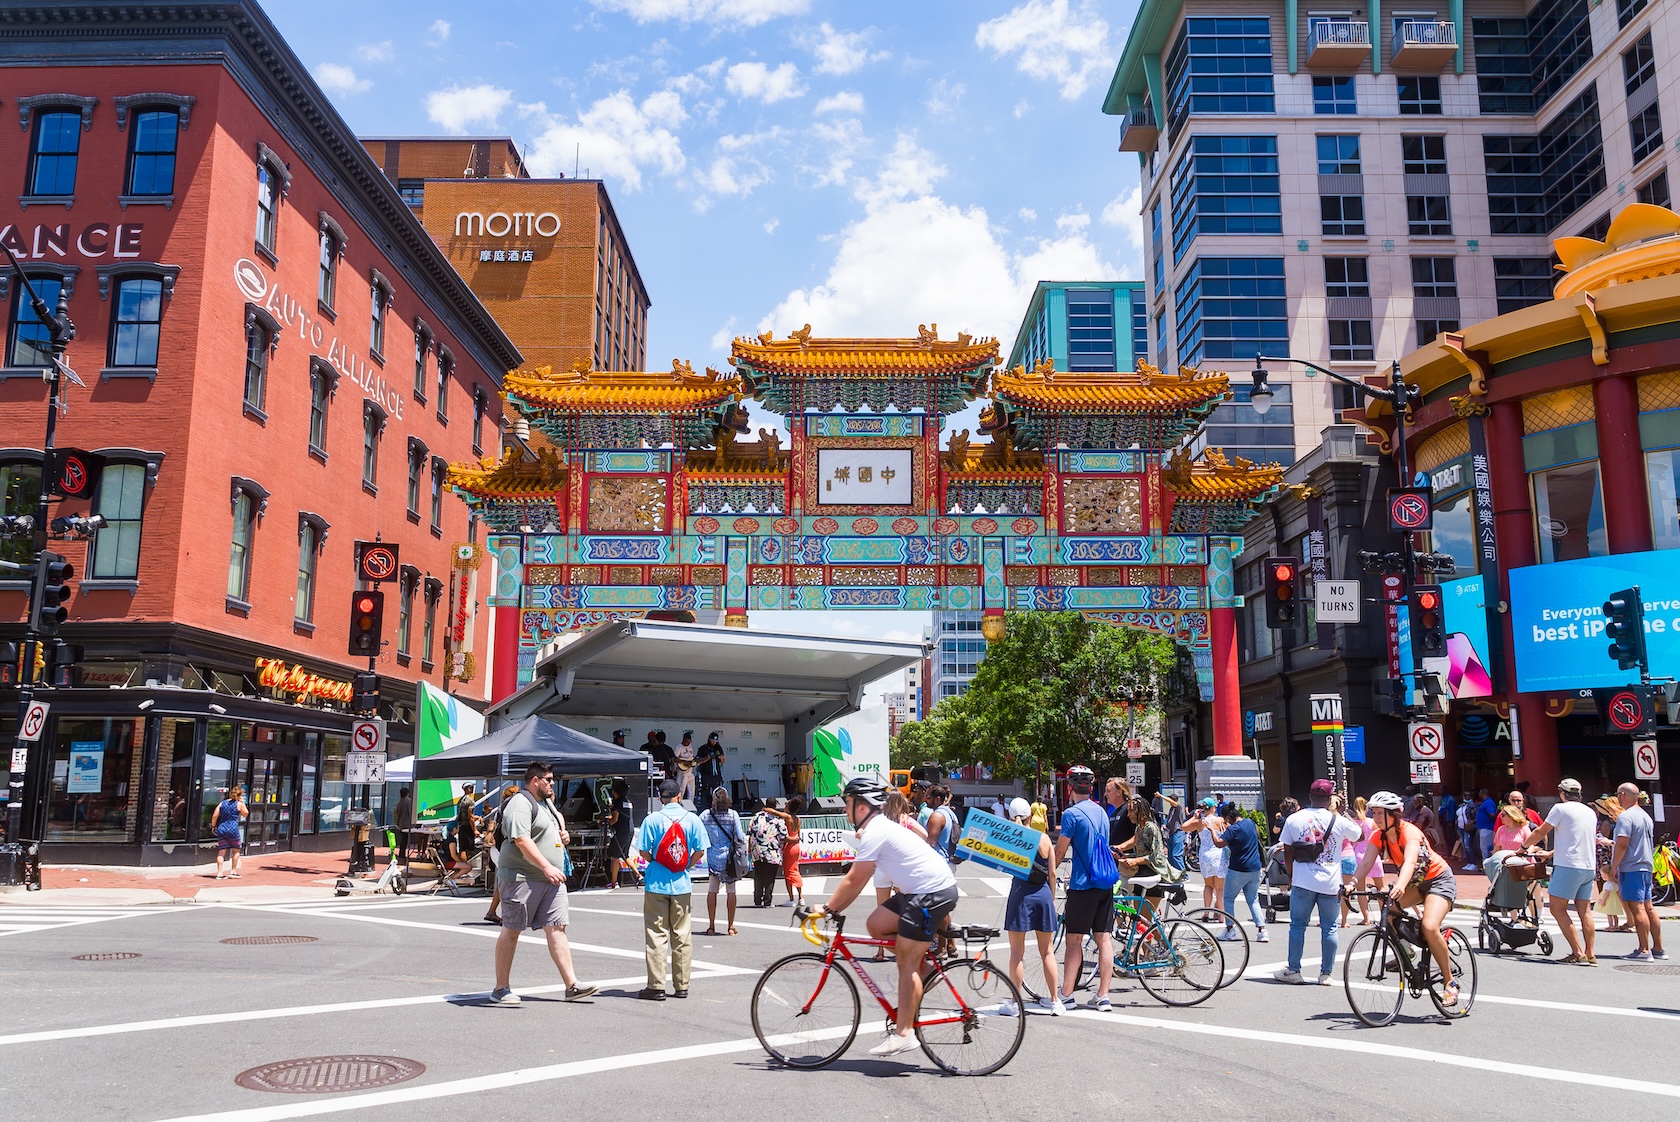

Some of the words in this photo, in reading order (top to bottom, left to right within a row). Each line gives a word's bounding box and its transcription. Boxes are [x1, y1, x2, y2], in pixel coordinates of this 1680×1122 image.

[480, 250, 534, 262] 摩庭酒店
[265, 283, 324, 349] AUTO
[327, 337, 404, 421] ALLIANCE
[1431, 464, 1462, 494] AT&T
[1473, 455, 1496, 562] 美國娛樂公司
[1330, 586, 1344, 595] NO
[1464, 583, 1479, 592] AT&T
[1321, 601, 1354, 611] TURNS
[1542, 605, 1603, 621] Everyon
[1532, 623, 1578, 642] best
[255, 656, 354, 703] Walgreens
[1311, 700, 1331, 720] M
[1332, 700, 1342, 720] M
[1254, 711, 1273, 732] AT&T
[1325, 735, 1334, 765] Gallery
[858, 763, 880, 772] DPR
[1129, 775, 1142, 784] 25
[971, 813, 1011, 833] REDUCIR
[1012, 828, 1024, 837] LA
[807, 831, 843, 844] STAGE
[991, 829, 1035, 851] VELOCIDAD
[965, 838, 983, 851] 20
[984, 846, 1005, 859] salva
[1007, 854, 1029, 868] vidas
